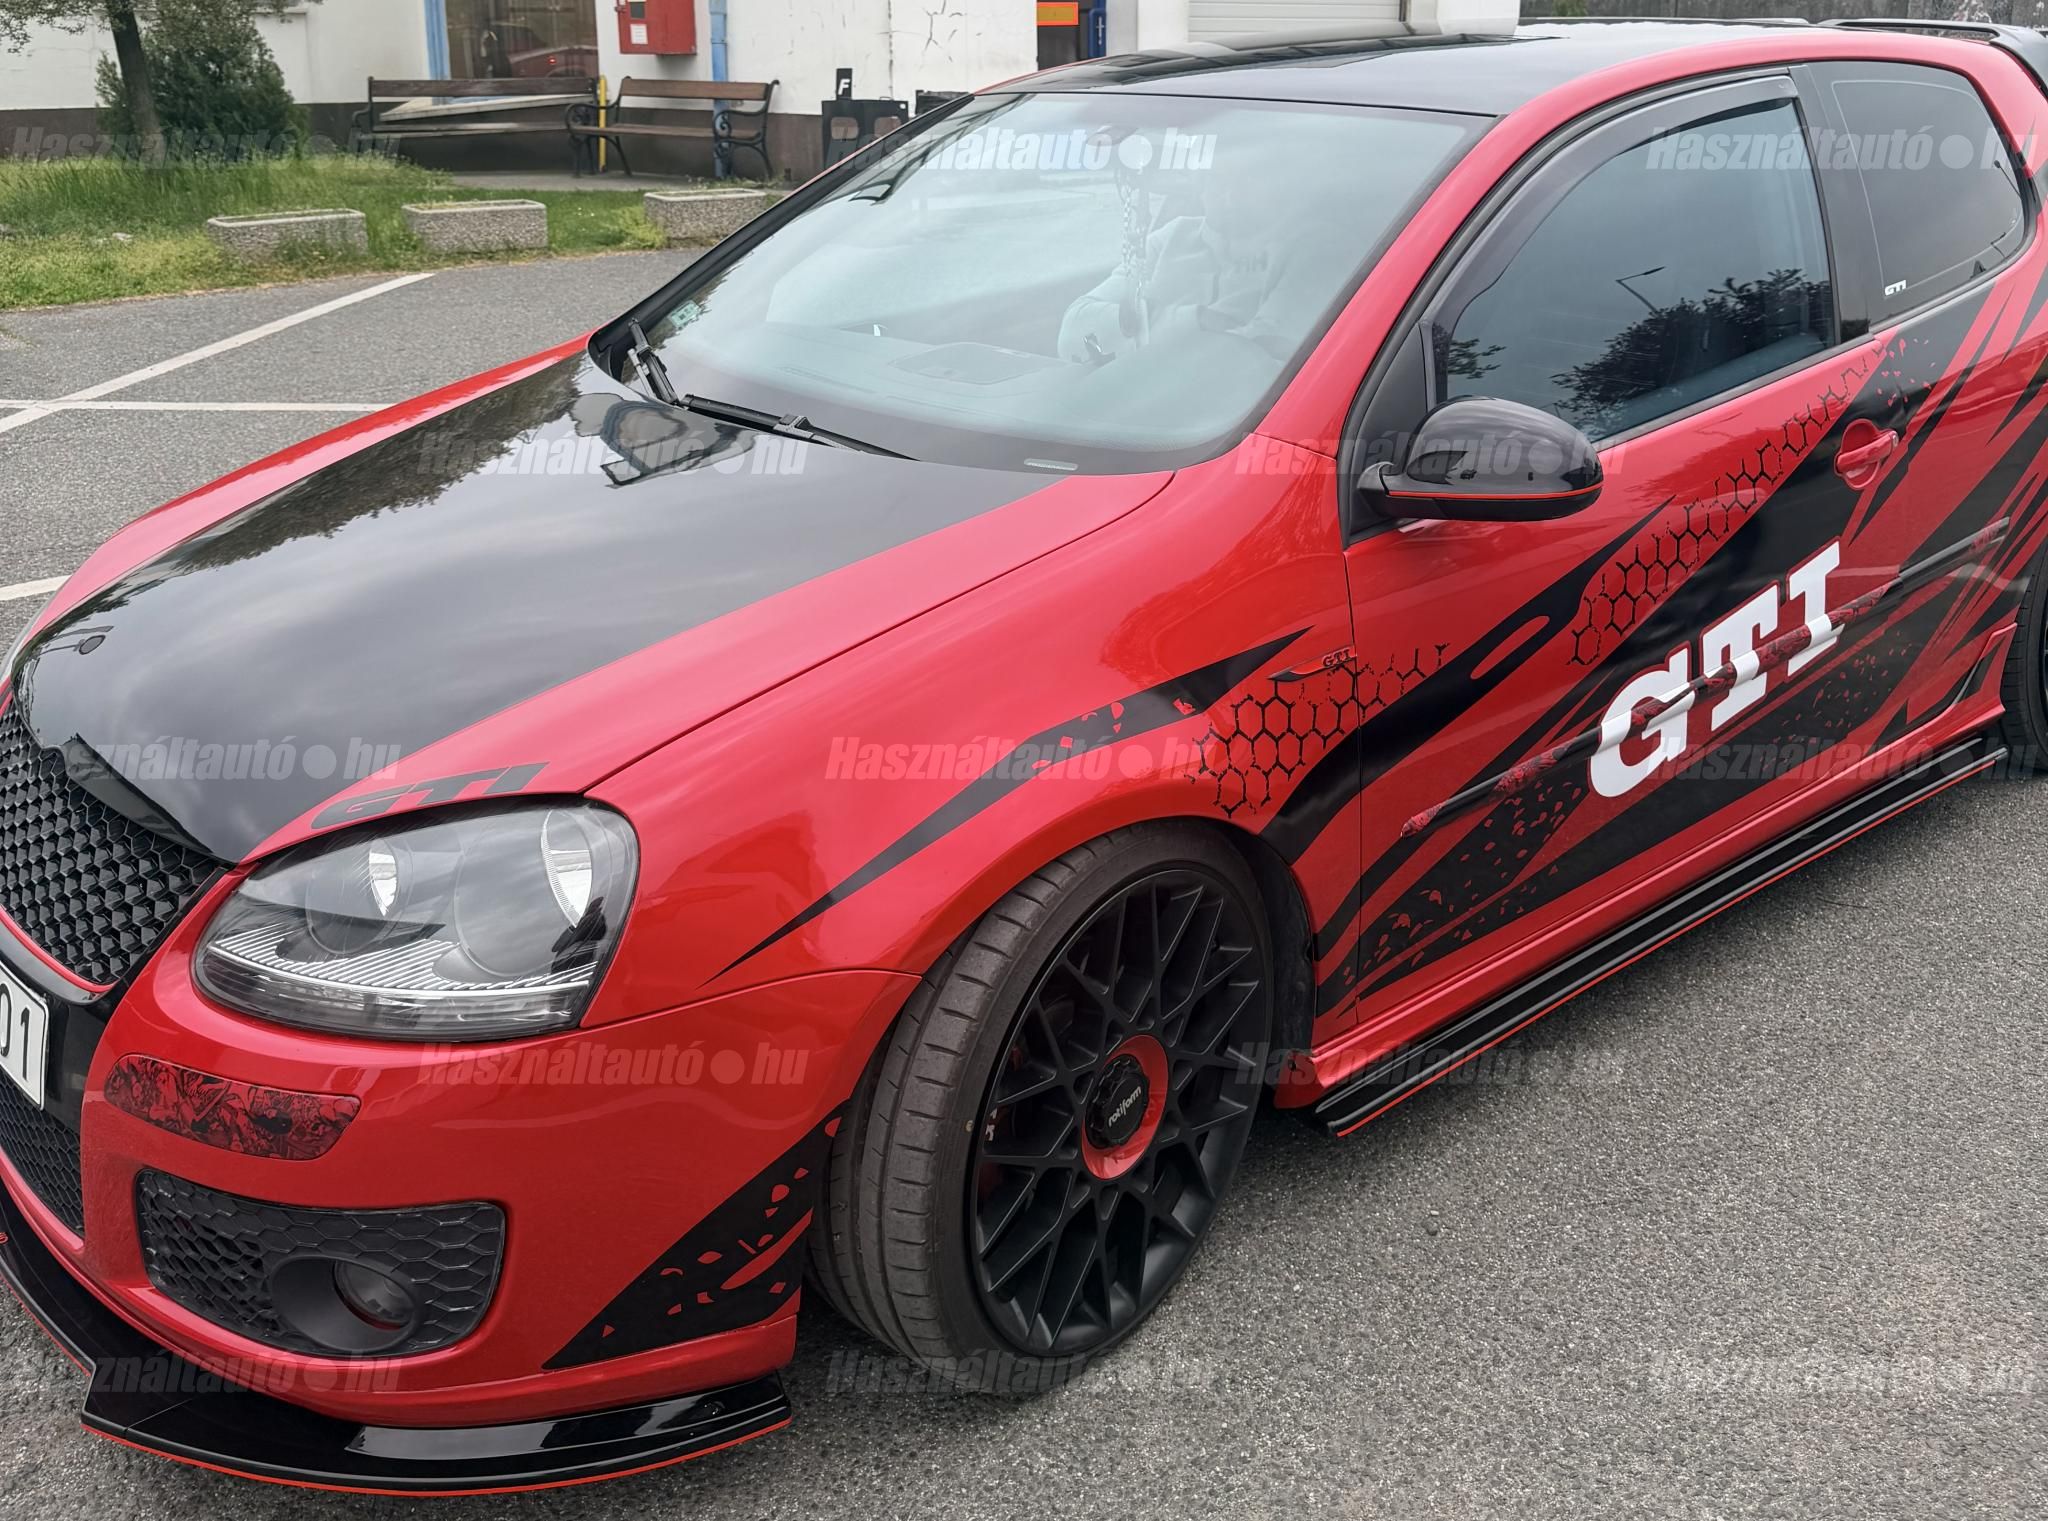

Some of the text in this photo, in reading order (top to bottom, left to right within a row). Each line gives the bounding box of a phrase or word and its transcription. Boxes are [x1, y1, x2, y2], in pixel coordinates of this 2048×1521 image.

[1884, 279, 1907, 296] GTI
[1322, 648, 1351, 668] GTI
[1590, 540, 1845, 798] GTI
[310, 760, 551, 830] GTI
[1107, 1085, 1142, 1128] rotiform
